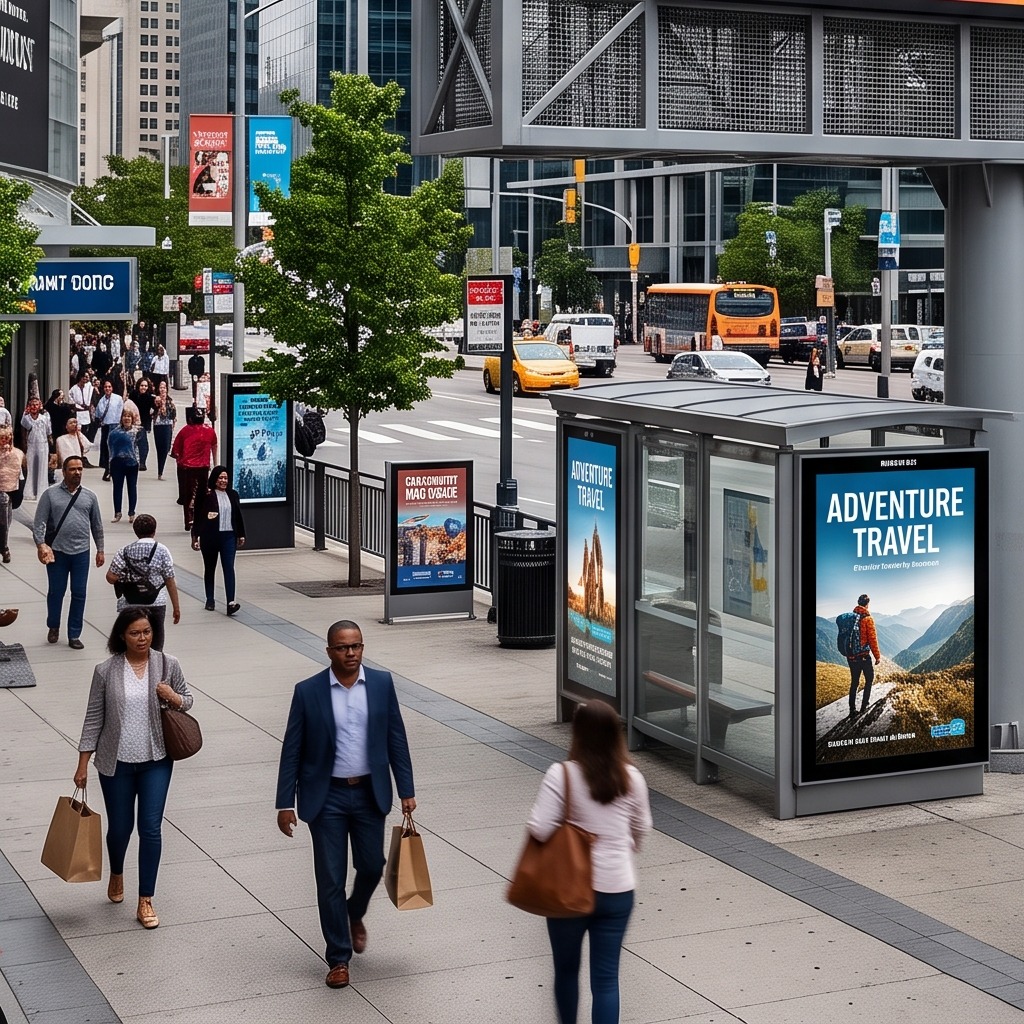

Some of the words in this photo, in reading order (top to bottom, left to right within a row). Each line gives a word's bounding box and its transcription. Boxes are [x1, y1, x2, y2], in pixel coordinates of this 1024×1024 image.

[571, 460, 613, 488] ADVENTURE
[577, 485, 605, 511] TRAVEL
[827, 487, 964, 523] ADVENTURE
[853, 524, 940, 558] TRAVEL
